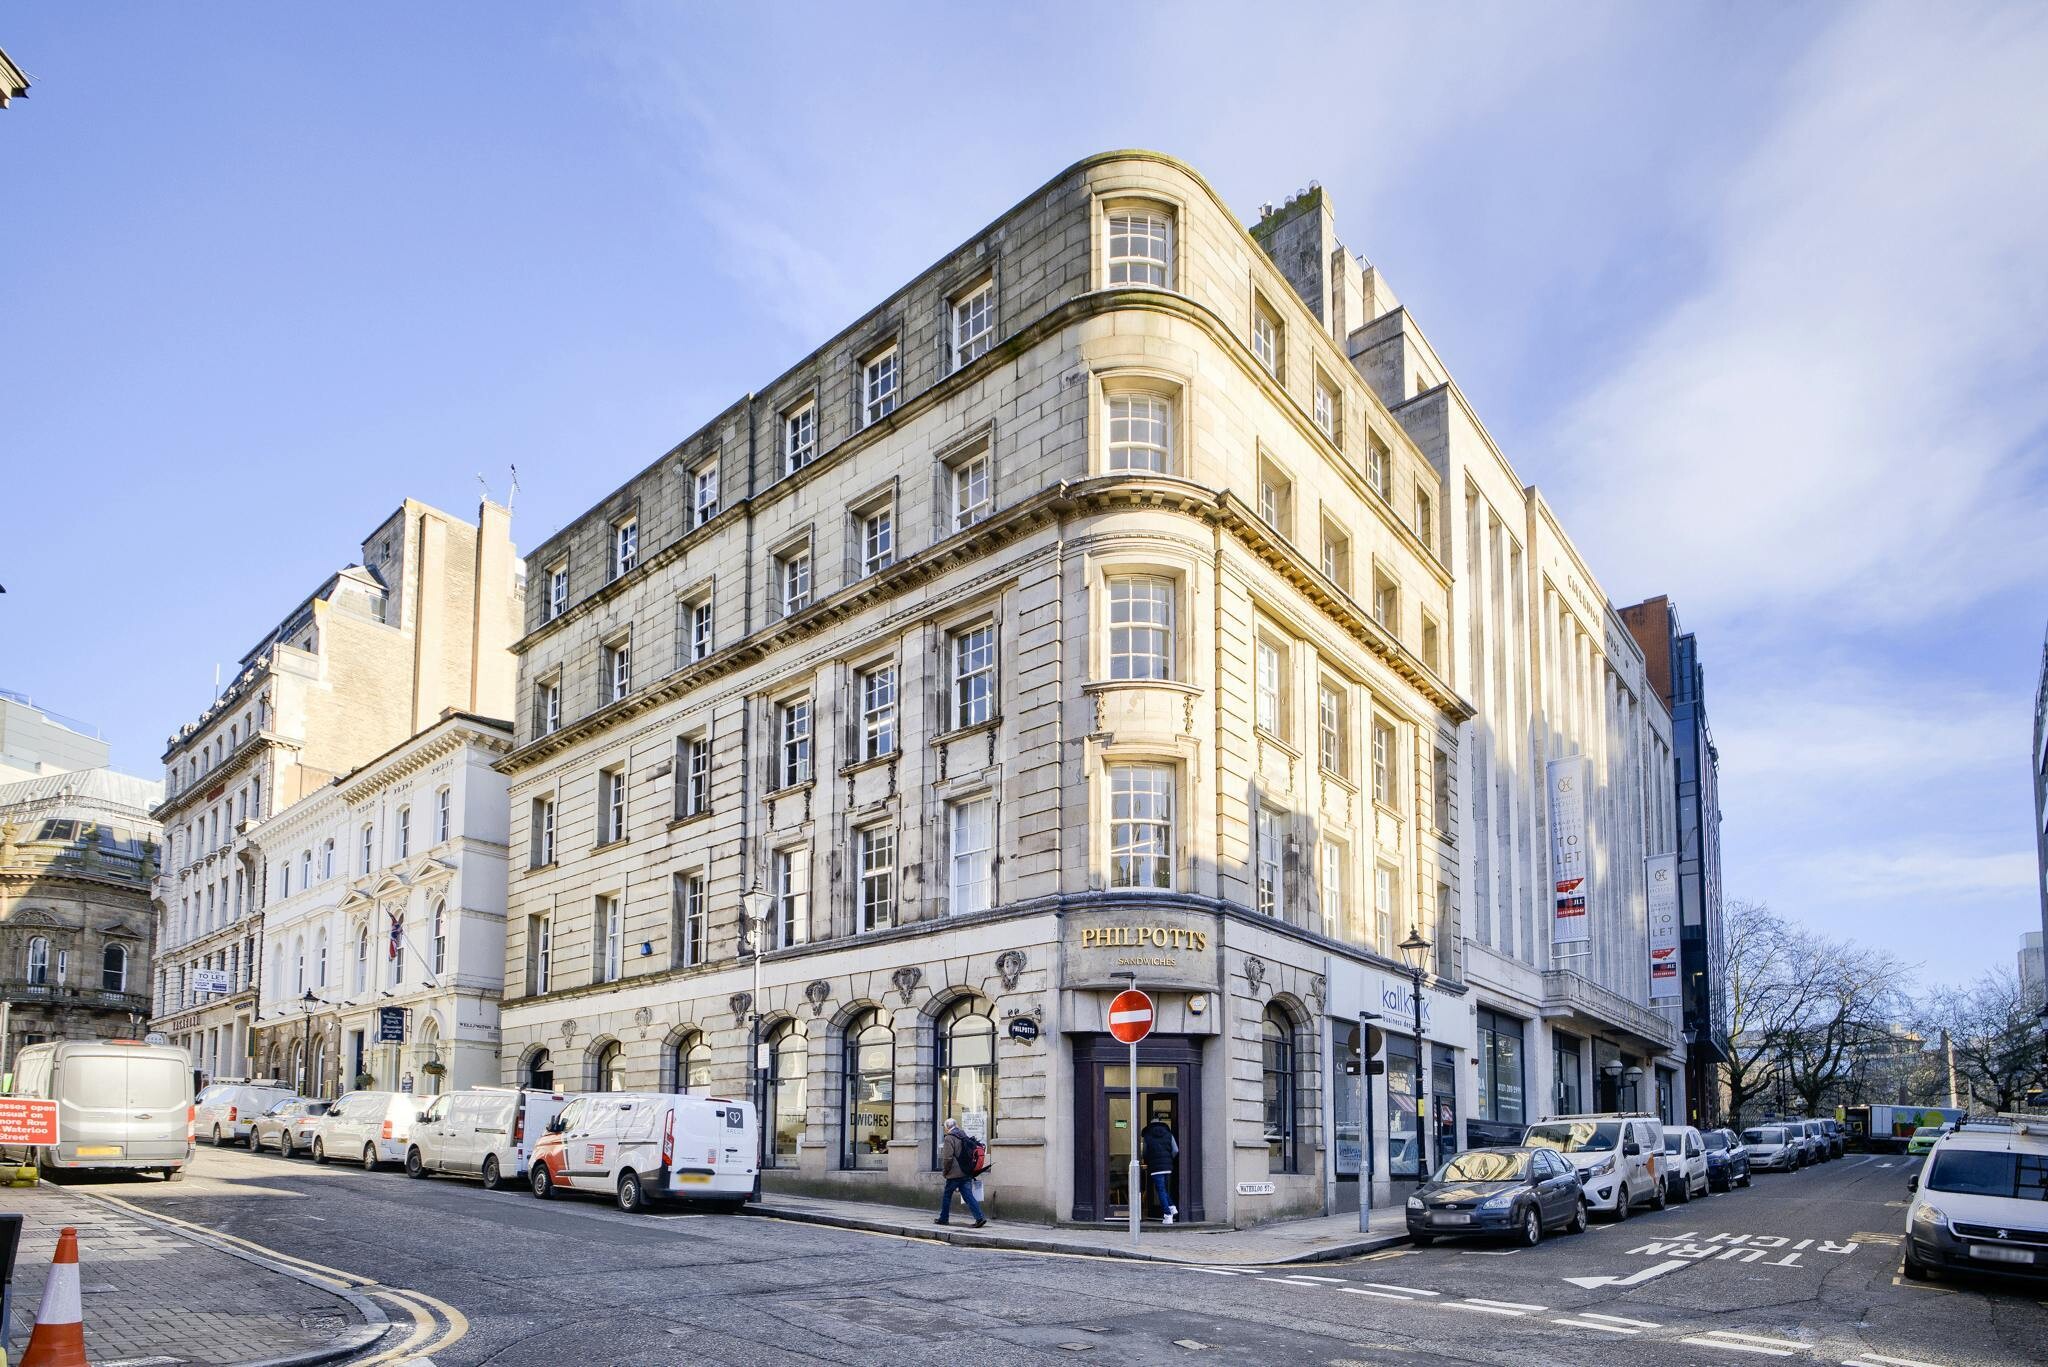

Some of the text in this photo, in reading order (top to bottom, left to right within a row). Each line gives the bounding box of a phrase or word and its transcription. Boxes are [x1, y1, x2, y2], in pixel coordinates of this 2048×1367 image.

[1557, 834, 1578, 847] TO
[1556, 851, 1582, 864] LET
[1654, 914, 1671, 923] TO
[1652, 927, 1674, 937] LET
[1082, 927, 1207, 951] PHILPOTTS
[1118, 957, 1176, 967] SANDWICHES
[1383, 1013, 1402, 1026] business
[26, 1119, 48, 1127] Row
[1, 1126, 48, 1134] Waterloo
[1240, 1185, 1263, 1193] WATERLOO
[1649, 1231, 1859, 1254] RIGHT
[1624, 1242, 1804, 1268] TURN
